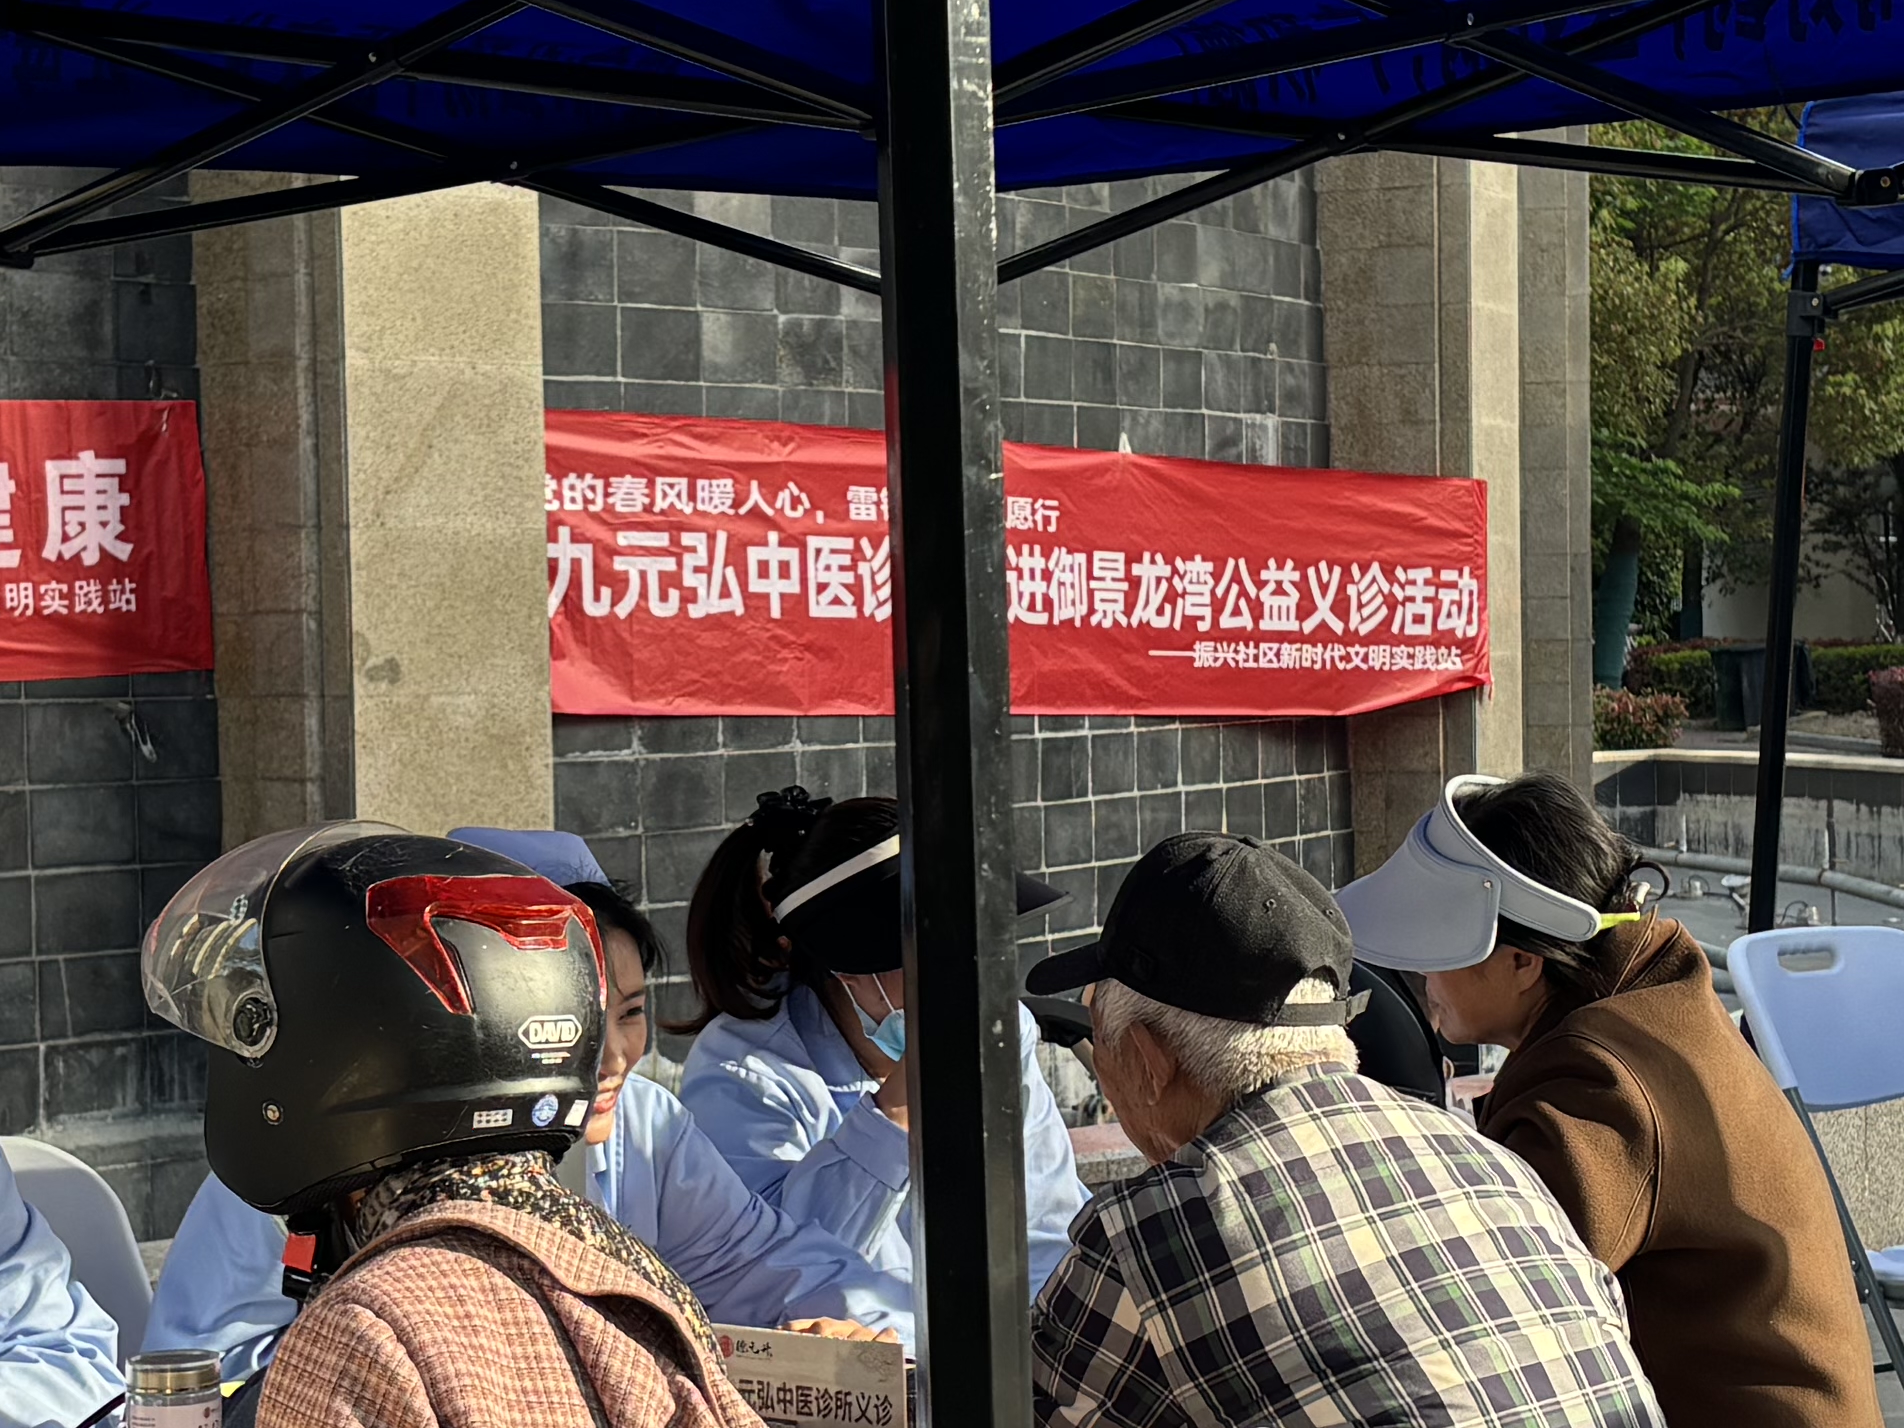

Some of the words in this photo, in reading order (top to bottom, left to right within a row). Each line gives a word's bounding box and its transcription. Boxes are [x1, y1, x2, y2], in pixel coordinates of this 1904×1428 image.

[545, 473, 889, 525] 的春风暖人心，雷
[1006, 543, 1479, 639] 进御景龙湾公益义诊活动
[529, 1020, 576, 1043] DAVID
